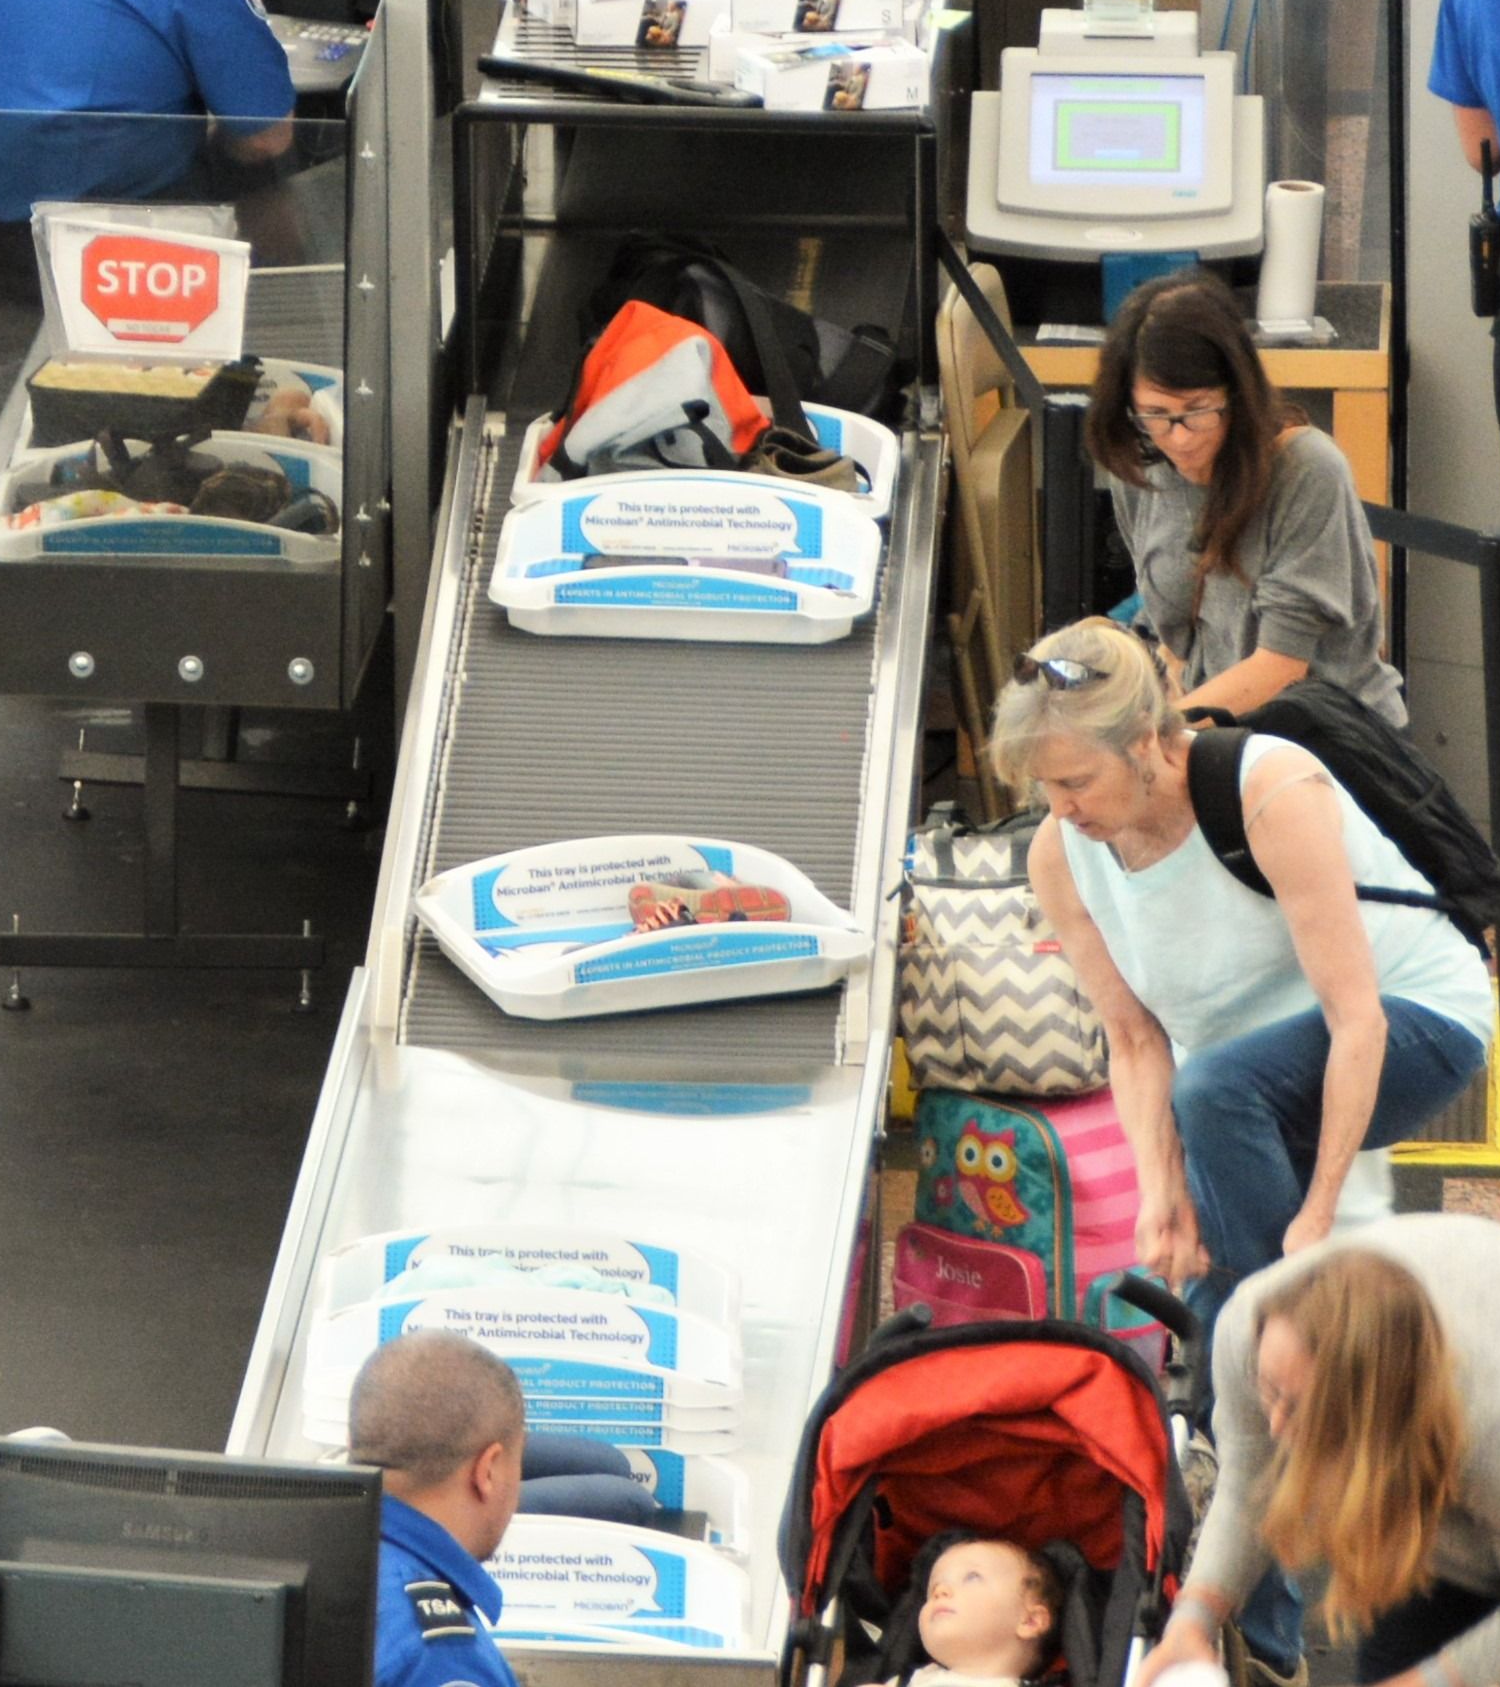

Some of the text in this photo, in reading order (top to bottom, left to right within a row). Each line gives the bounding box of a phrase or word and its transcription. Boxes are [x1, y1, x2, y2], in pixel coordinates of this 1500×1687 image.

[96, 259, 207, 299] STOP
[617, 502, 761, 517] This tray is protected with
[646, 517, 723, 529] Antimicrobial
[727, 519, 792, 532] Technology
[528, 855, 672, 879] This tray is protected with
[558, 872, 635, 891] Antimicrobial
[448, 1245, 609, 1261] This is protected with
[935, 1255, 984, 1289] Josie
[444, 1308, 608, 1327] This tray is protected with
[477, 1325, 645, 1344] Antimicrobial Technology
[504, 1552, 516, 1563] is
[518, 1553, 582, 1566] protected
[584, 1555, 614, 1566] with
[489, 1569, 651, 1586] ntimicrobial Technology
[416, 1598, 462, 1617] TSA
